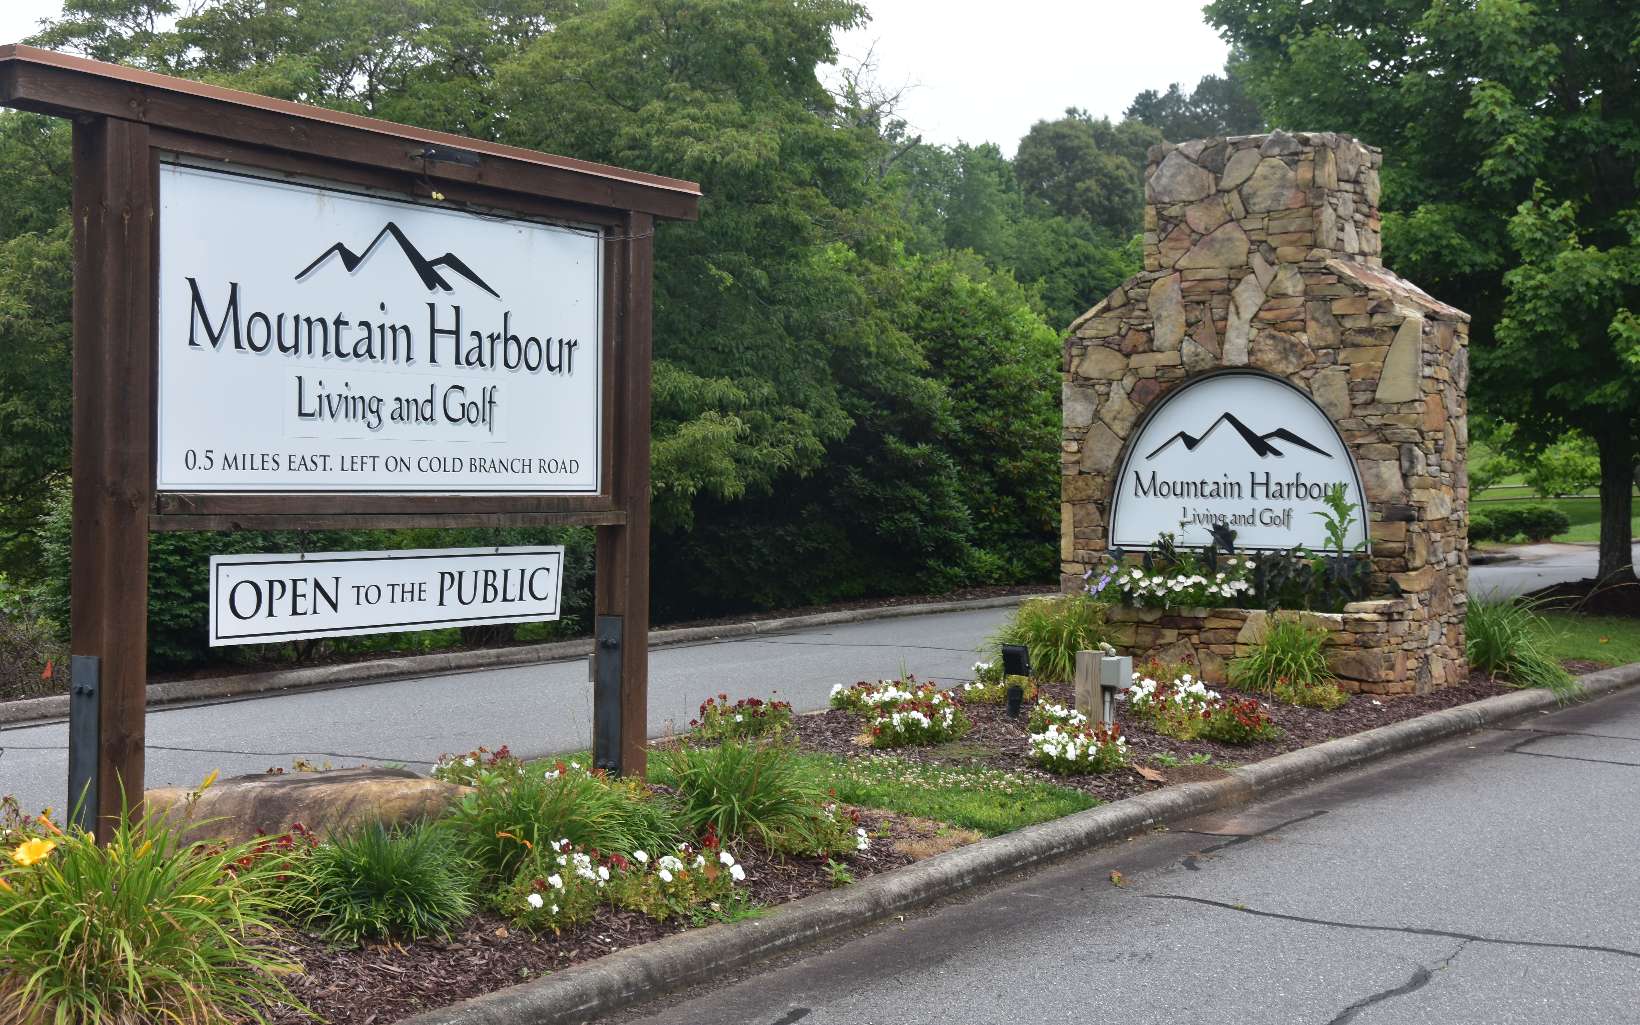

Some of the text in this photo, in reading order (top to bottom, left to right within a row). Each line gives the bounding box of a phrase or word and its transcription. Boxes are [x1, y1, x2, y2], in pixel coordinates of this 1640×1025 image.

[185, 276, 579, 374] Mountain Harbour
[296, 375, 497, 432] Living and Golf
[184, 449, 580, 474] 0.5 MILES EAST. LEFT ON COLD BRANCH ROAD
[1133, 470, 1242, 498] Mountain
[1229, 507, 1255, 527] and
[1259, 507, 1293, 529] Golf
[228, 566, 551, 621] OPEN TO THE PUBLIC
